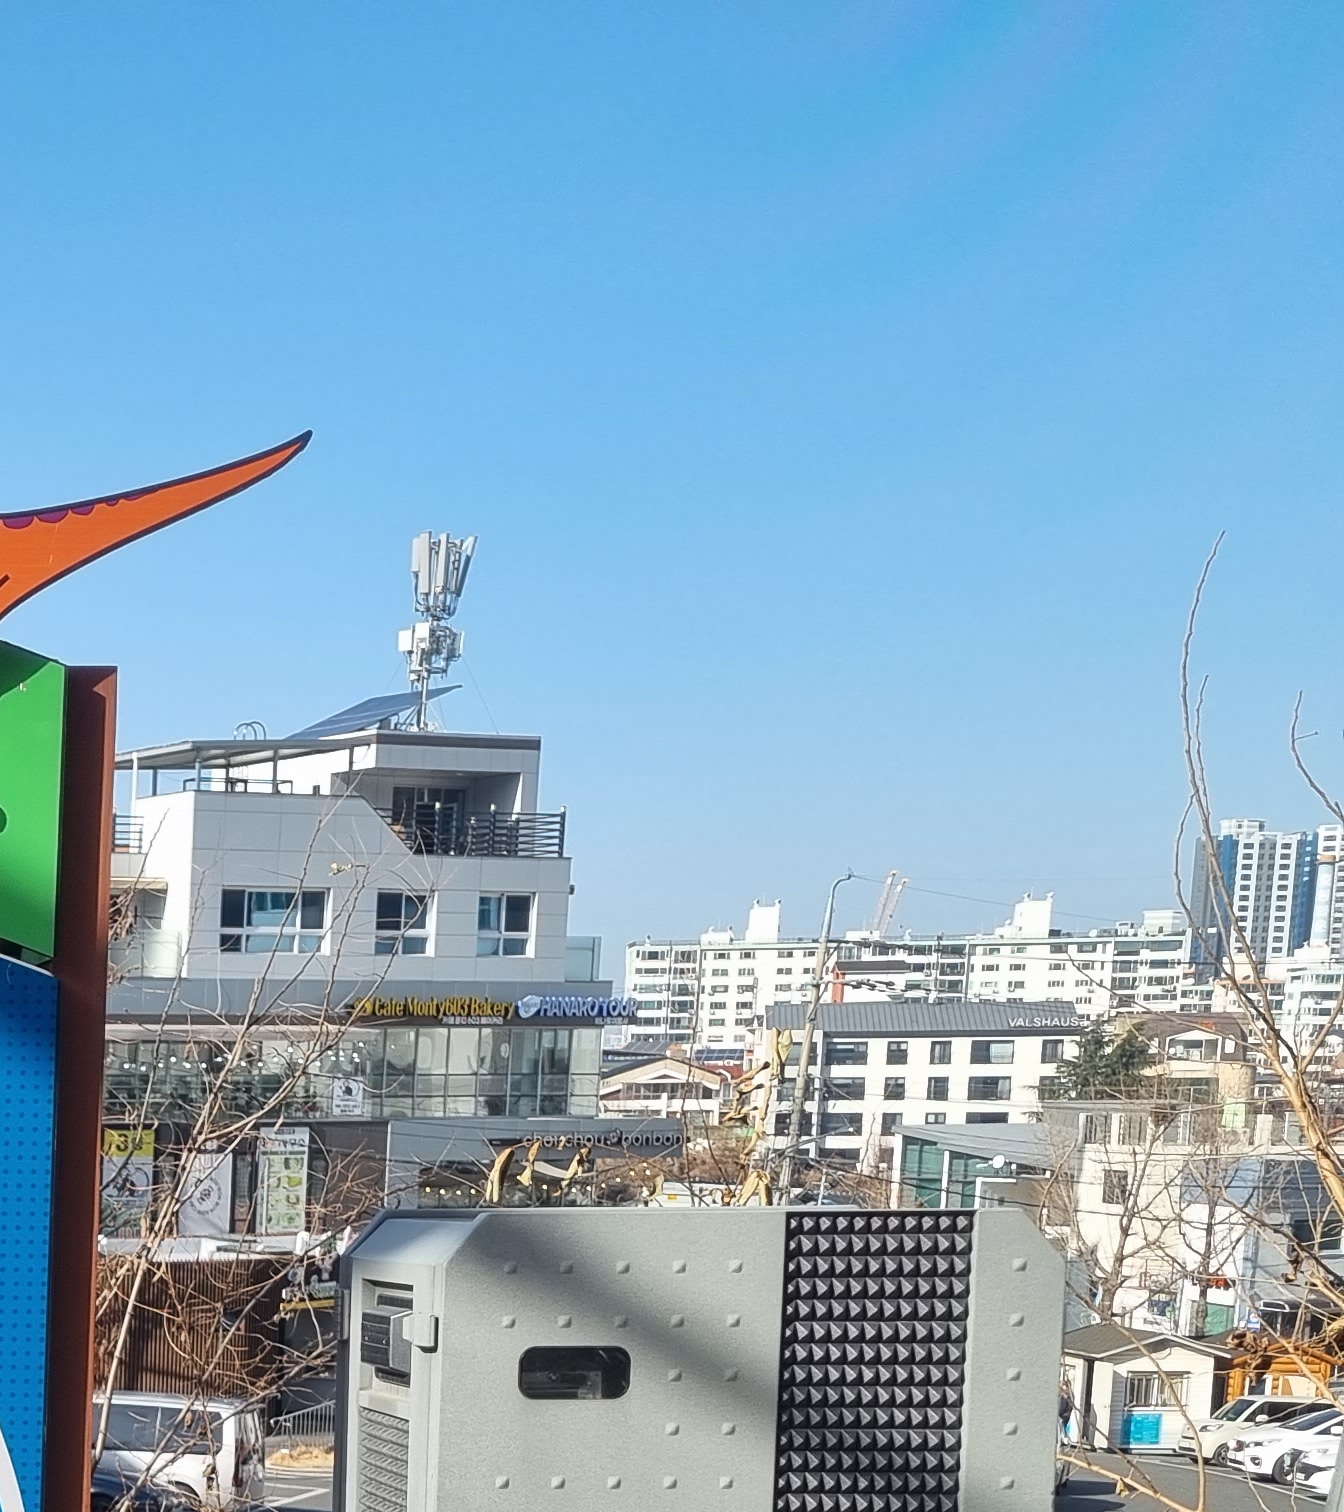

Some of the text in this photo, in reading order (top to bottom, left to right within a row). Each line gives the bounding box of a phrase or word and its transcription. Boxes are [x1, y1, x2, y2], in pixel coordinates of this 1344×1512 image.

[375, 997, 404, 1016] Cafe
[470, 997, 515, 1019] Bakery
[540, 997, 598, 1017] HANARO
[599, 997, 638, 1017] TOUR
[1008, 1017, 1079, 1027] VALSHAUS
[622, 1132, 683, 1146] bonbon
